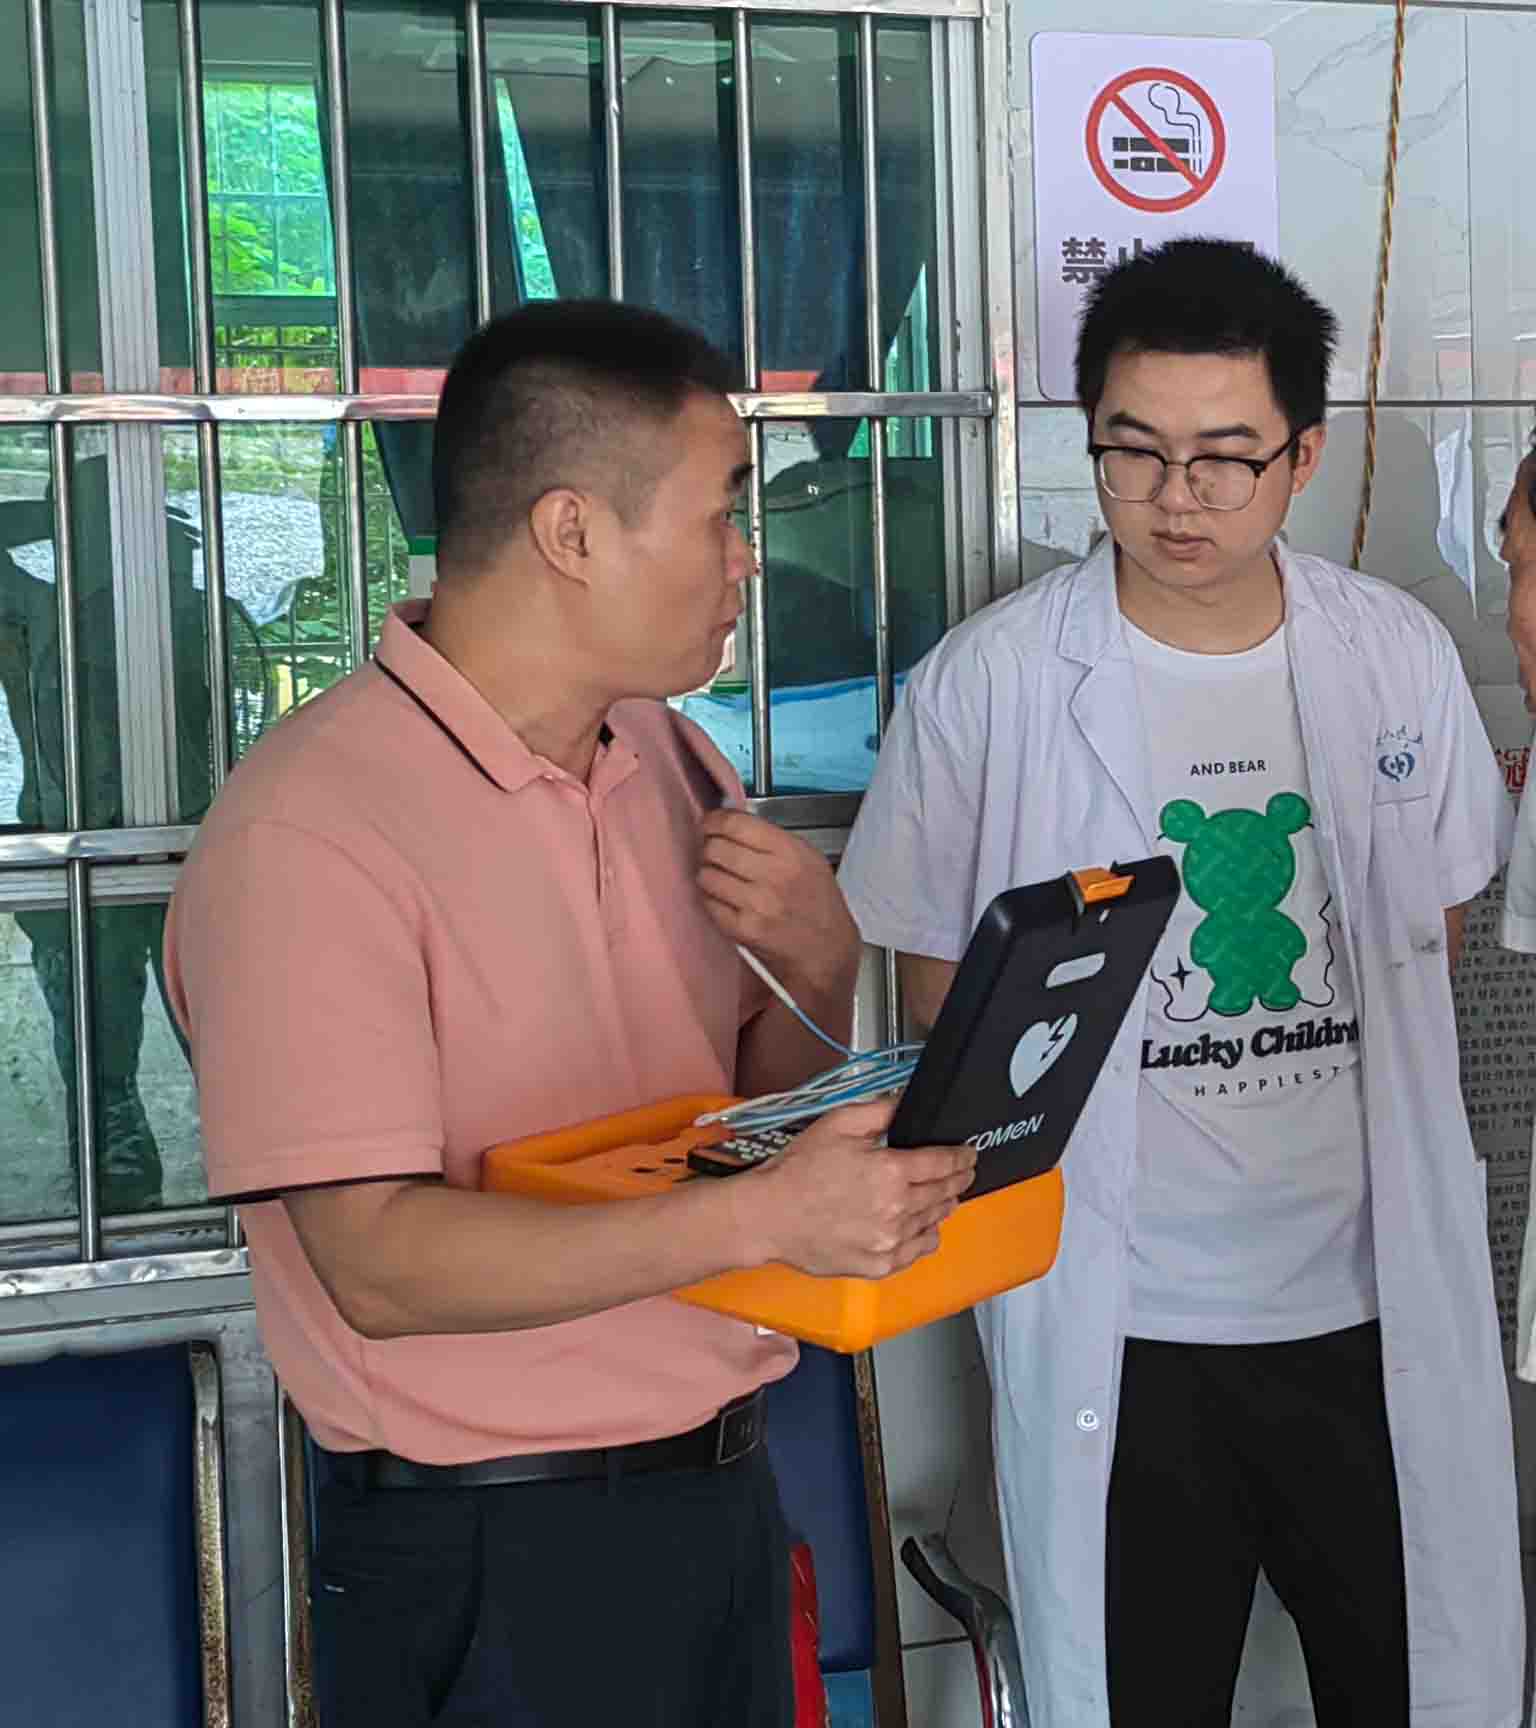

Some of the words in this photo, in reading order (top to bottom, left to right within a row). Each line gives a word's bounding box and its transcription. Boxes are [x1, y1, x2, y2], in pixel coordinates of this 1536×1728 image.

[1190, 762, 1224, 776] AND
[1229, 759, 1266, 774] BEAR
[1141, 1033, 1244, 1070] Lucky
[1194, 1065, 1342, 1097] HAPPIEST
